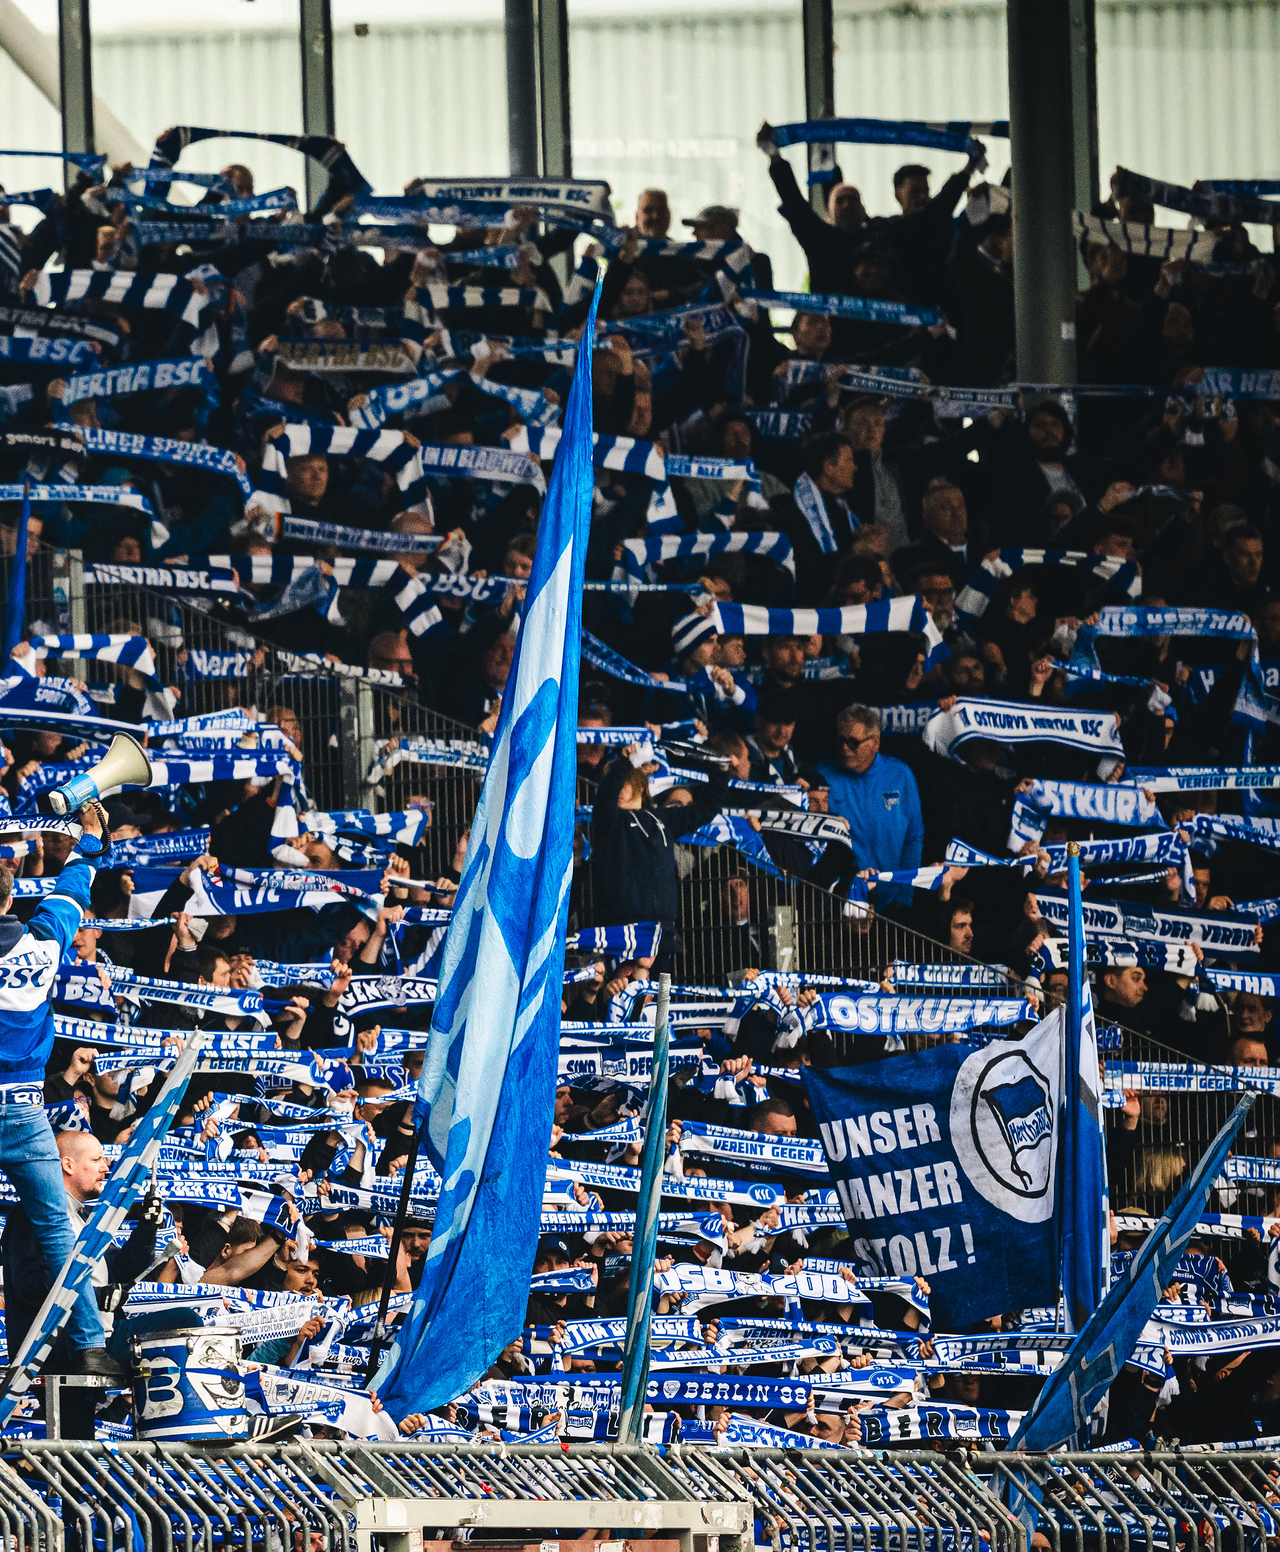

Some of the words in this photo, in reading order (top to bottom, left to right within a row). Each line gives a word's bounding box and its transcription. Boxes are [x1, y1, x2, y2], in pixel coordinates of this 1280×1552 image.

[28, 336, 93, 364] BSC
[63, 367, 150, 399] HERTHA
[153, 359, 207, 388] BSC
[96, 564, 173, 586] HERTHA
[177, 568, 211, 589] BSC
[974, 711, 1028, 729] OSTKURVE
[1032, 714, 1077, 731] HERTHA
[1080, 719, 1104, 738] BSC
[1177, 774, 1231, 788] VEREINT
[1160, 919, 1192, 939] DER
[139, 985, 182, 1003] GEGEN
[185, 992, 215, 1007] ALLE
[830, 997, 1022, 1032] OSTKURVE
[118, 1025, 162, 1046] UND
[221, 1034, 266, 1049] KSC
[210, 1058, 249, 1073] GEGEN
[255, 1061, 285, 1074] ALLE
[1144, 1076, 1193, 1089] VEREINT
[714, 1139, 765, 1158] VEREINT
[771, 1146, 816, 1161] GEGEN
[583, 1173, 638, 1190] VEREINT
[854, 1226, 957, 1277] STOLZ
[964, 1223, 976, 1264] !
